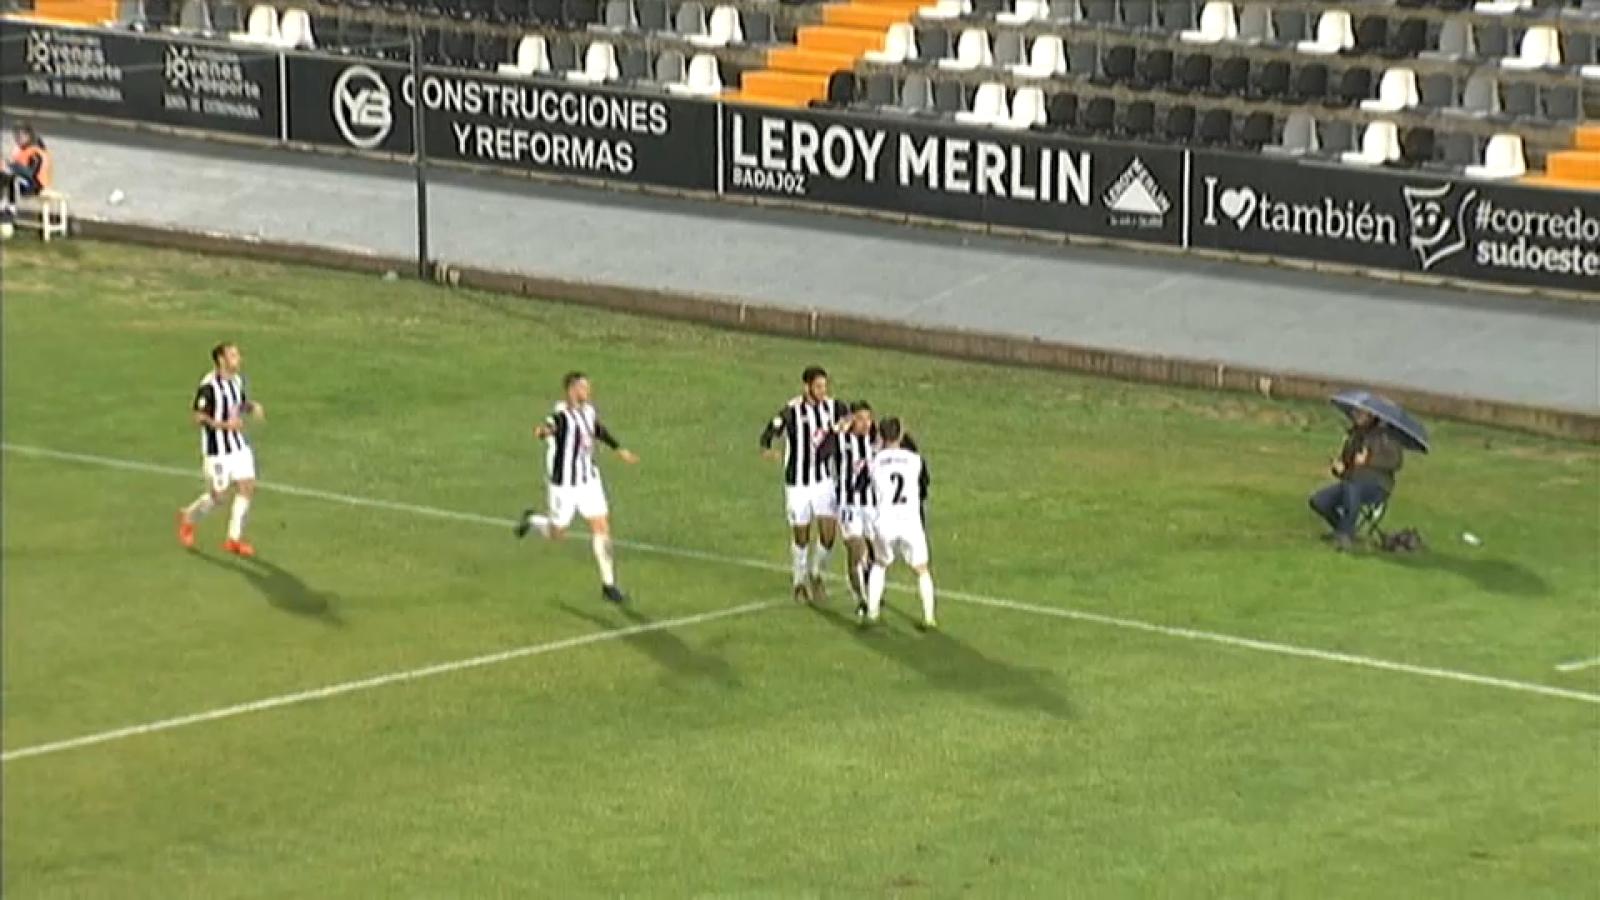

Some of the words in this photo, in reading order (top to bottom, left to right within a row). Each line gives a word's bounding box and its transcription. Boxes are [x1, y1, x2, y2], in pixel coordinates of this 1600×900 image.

[402, 74, 668, 135] CONSTRUCCIONES
[732, 112, 886, 182] LEROY
[900, 132, 1092, 206] MERLIN
[732, 169, 806, 195] BADAJOZ
[1259, 193, 1397, 246] también
[1475, 199, 1600, 241] #corredo
[1476, 235, 1600, 276] sudoeste
[889, 472, 908, 506] 2
